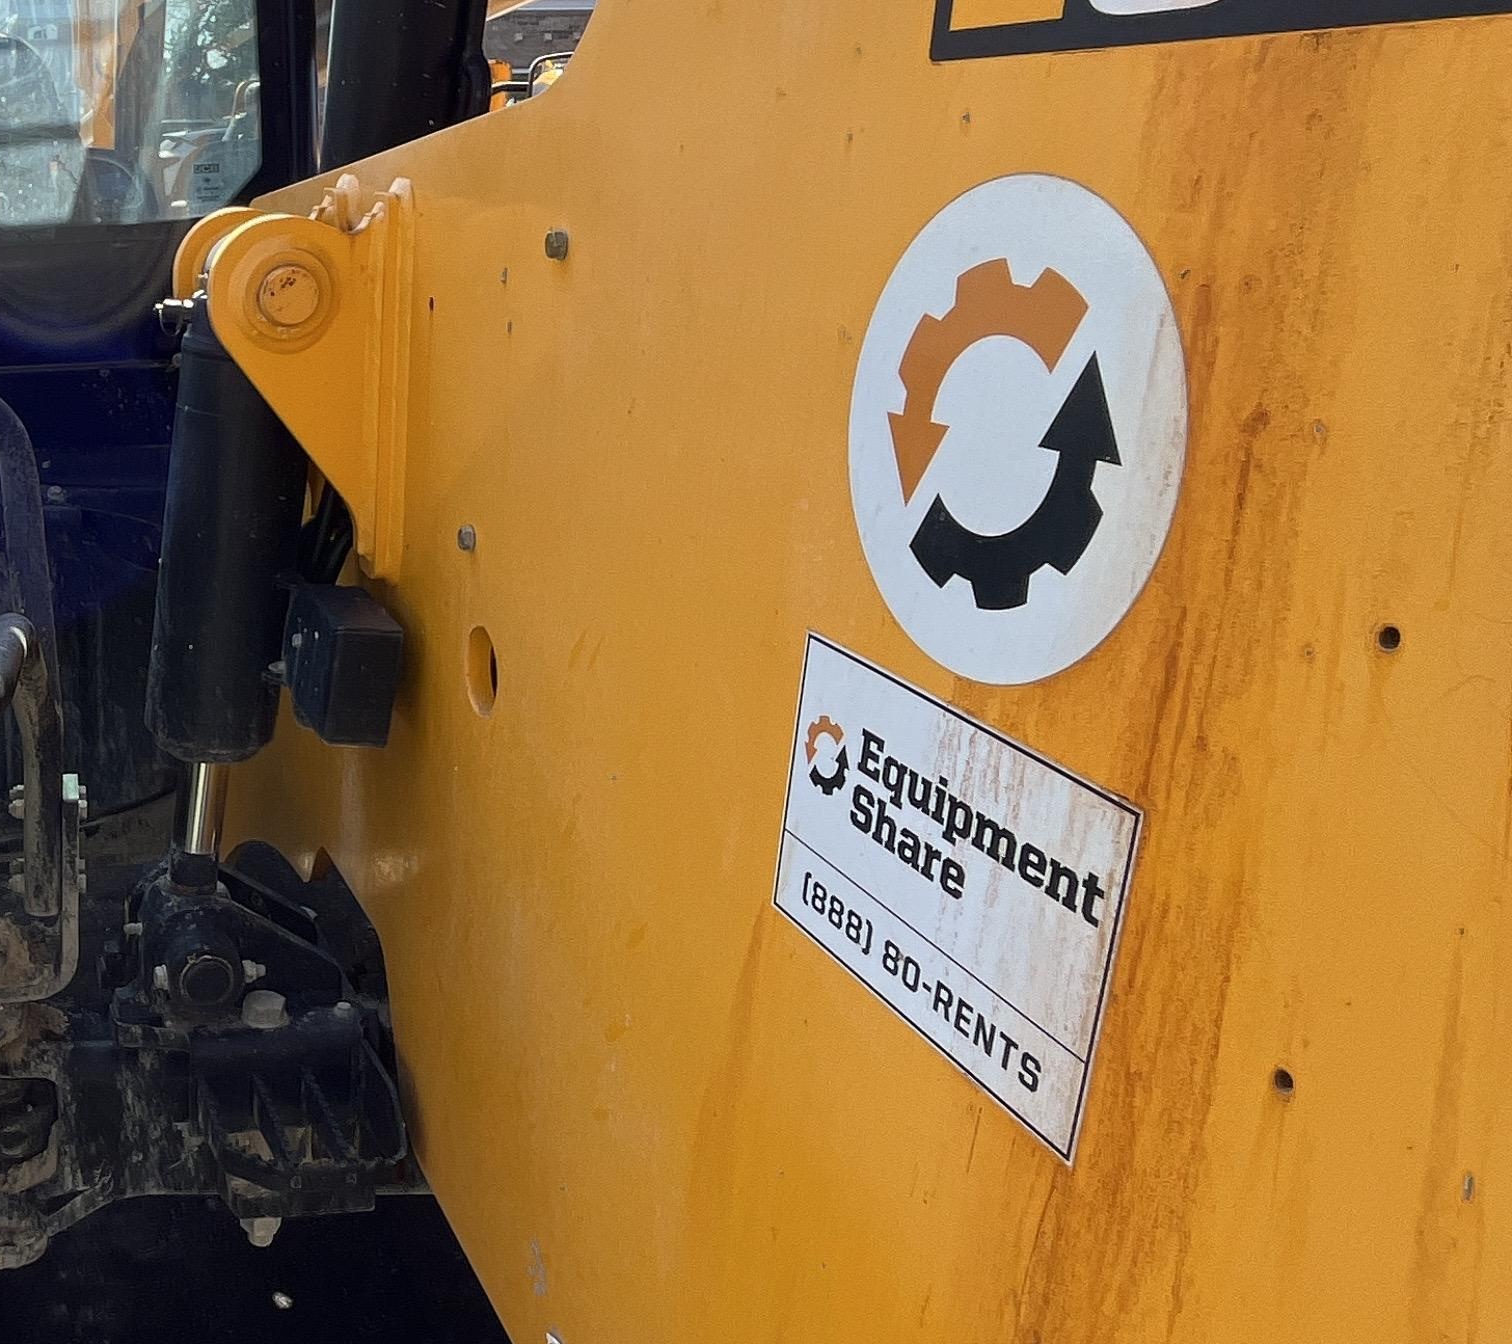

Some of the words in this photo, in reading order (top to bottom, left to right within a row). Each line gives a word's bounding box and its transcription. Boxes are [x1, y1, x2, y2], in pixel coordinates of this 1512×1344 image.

[849, 784, 966, 900] Share
[856, 727, 1106, 927] Equipment
[802, 872, 873, 956] (888)
[882, 940, 1042, 1094] 80-RENTS
